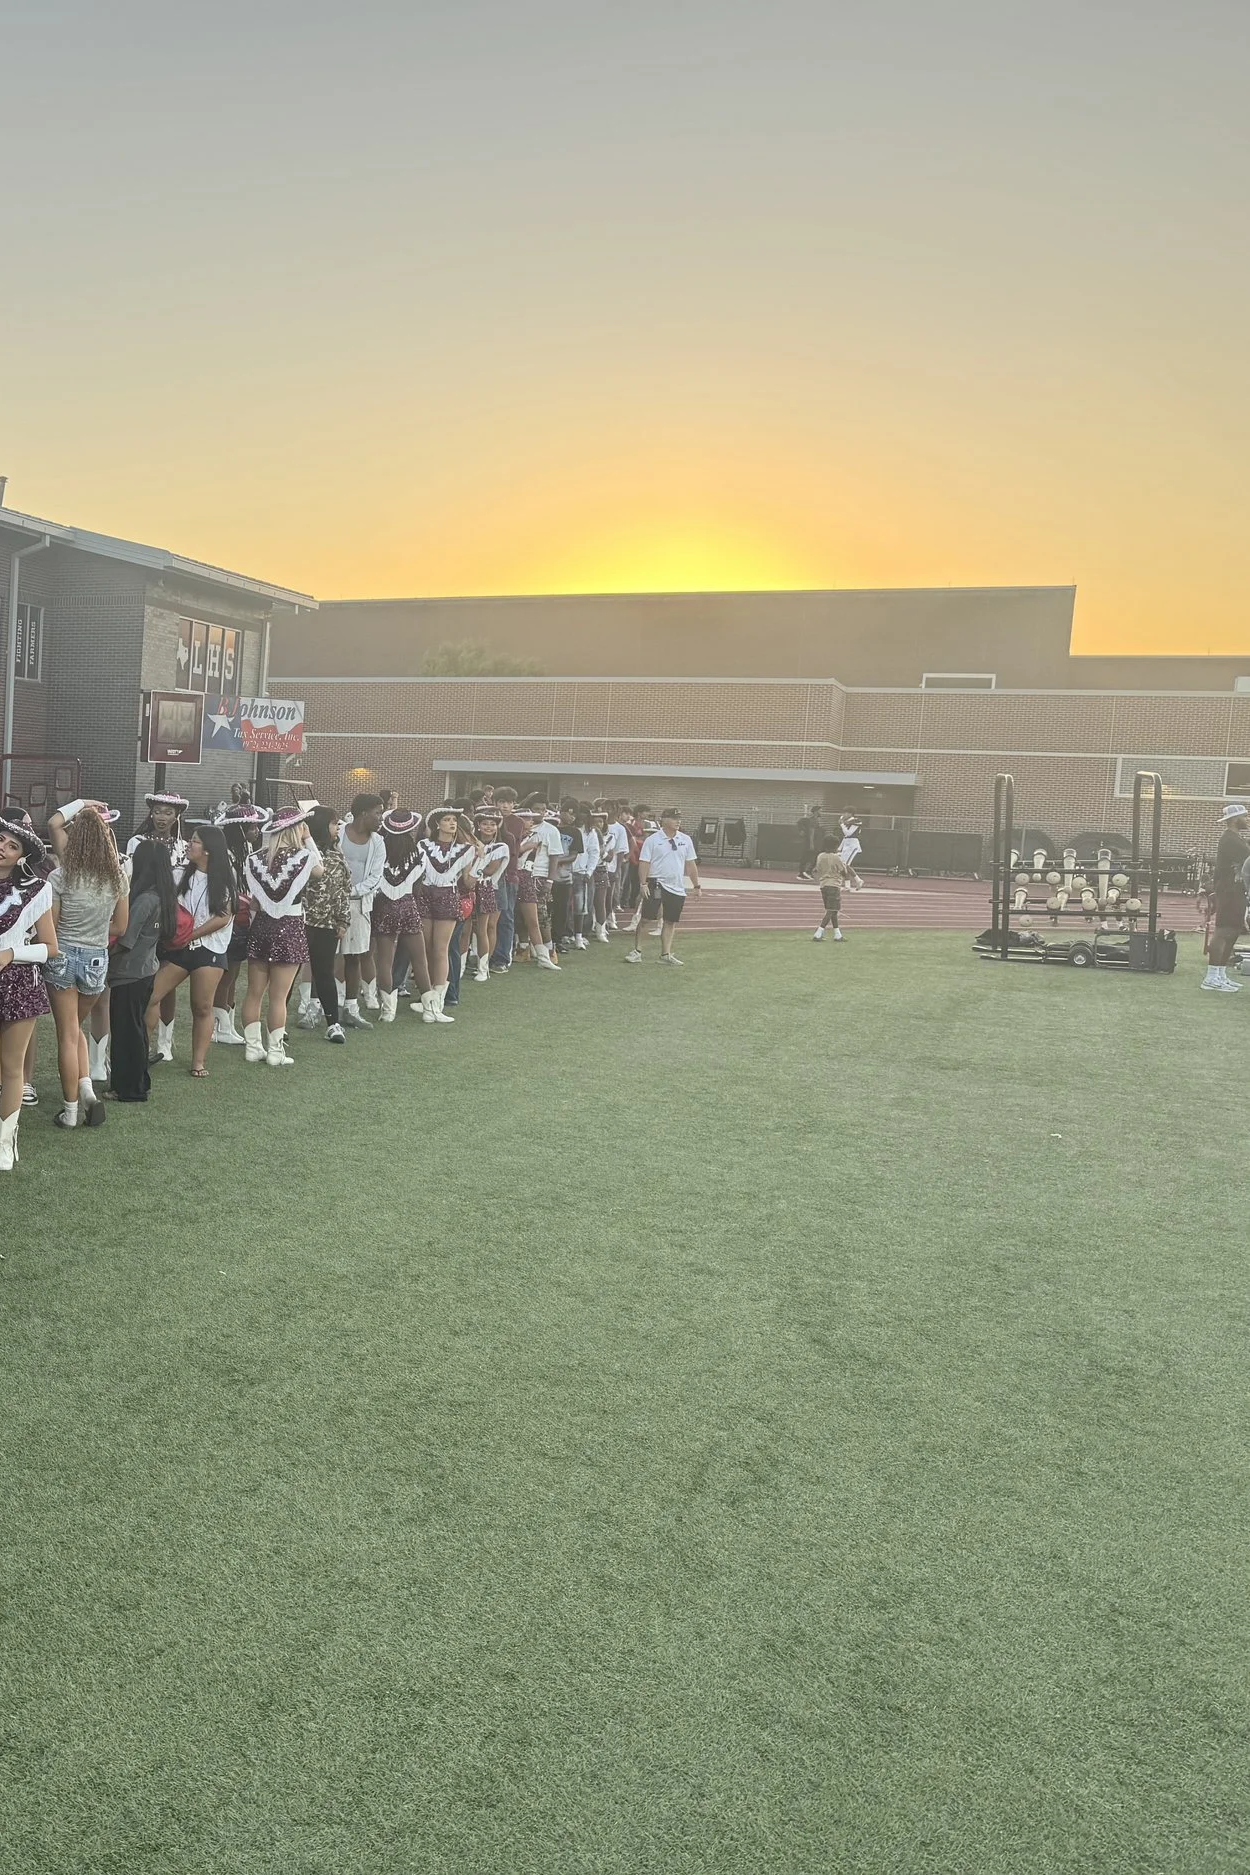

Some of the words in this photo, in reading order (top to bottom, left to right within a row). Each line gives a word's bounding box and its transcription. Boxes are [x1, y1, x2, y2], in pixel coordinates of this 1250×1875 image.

[192, 640, 235, 680] LHS
[233, 727, 248, 739] Tax
[284, 732, 300, 742] Inc.
